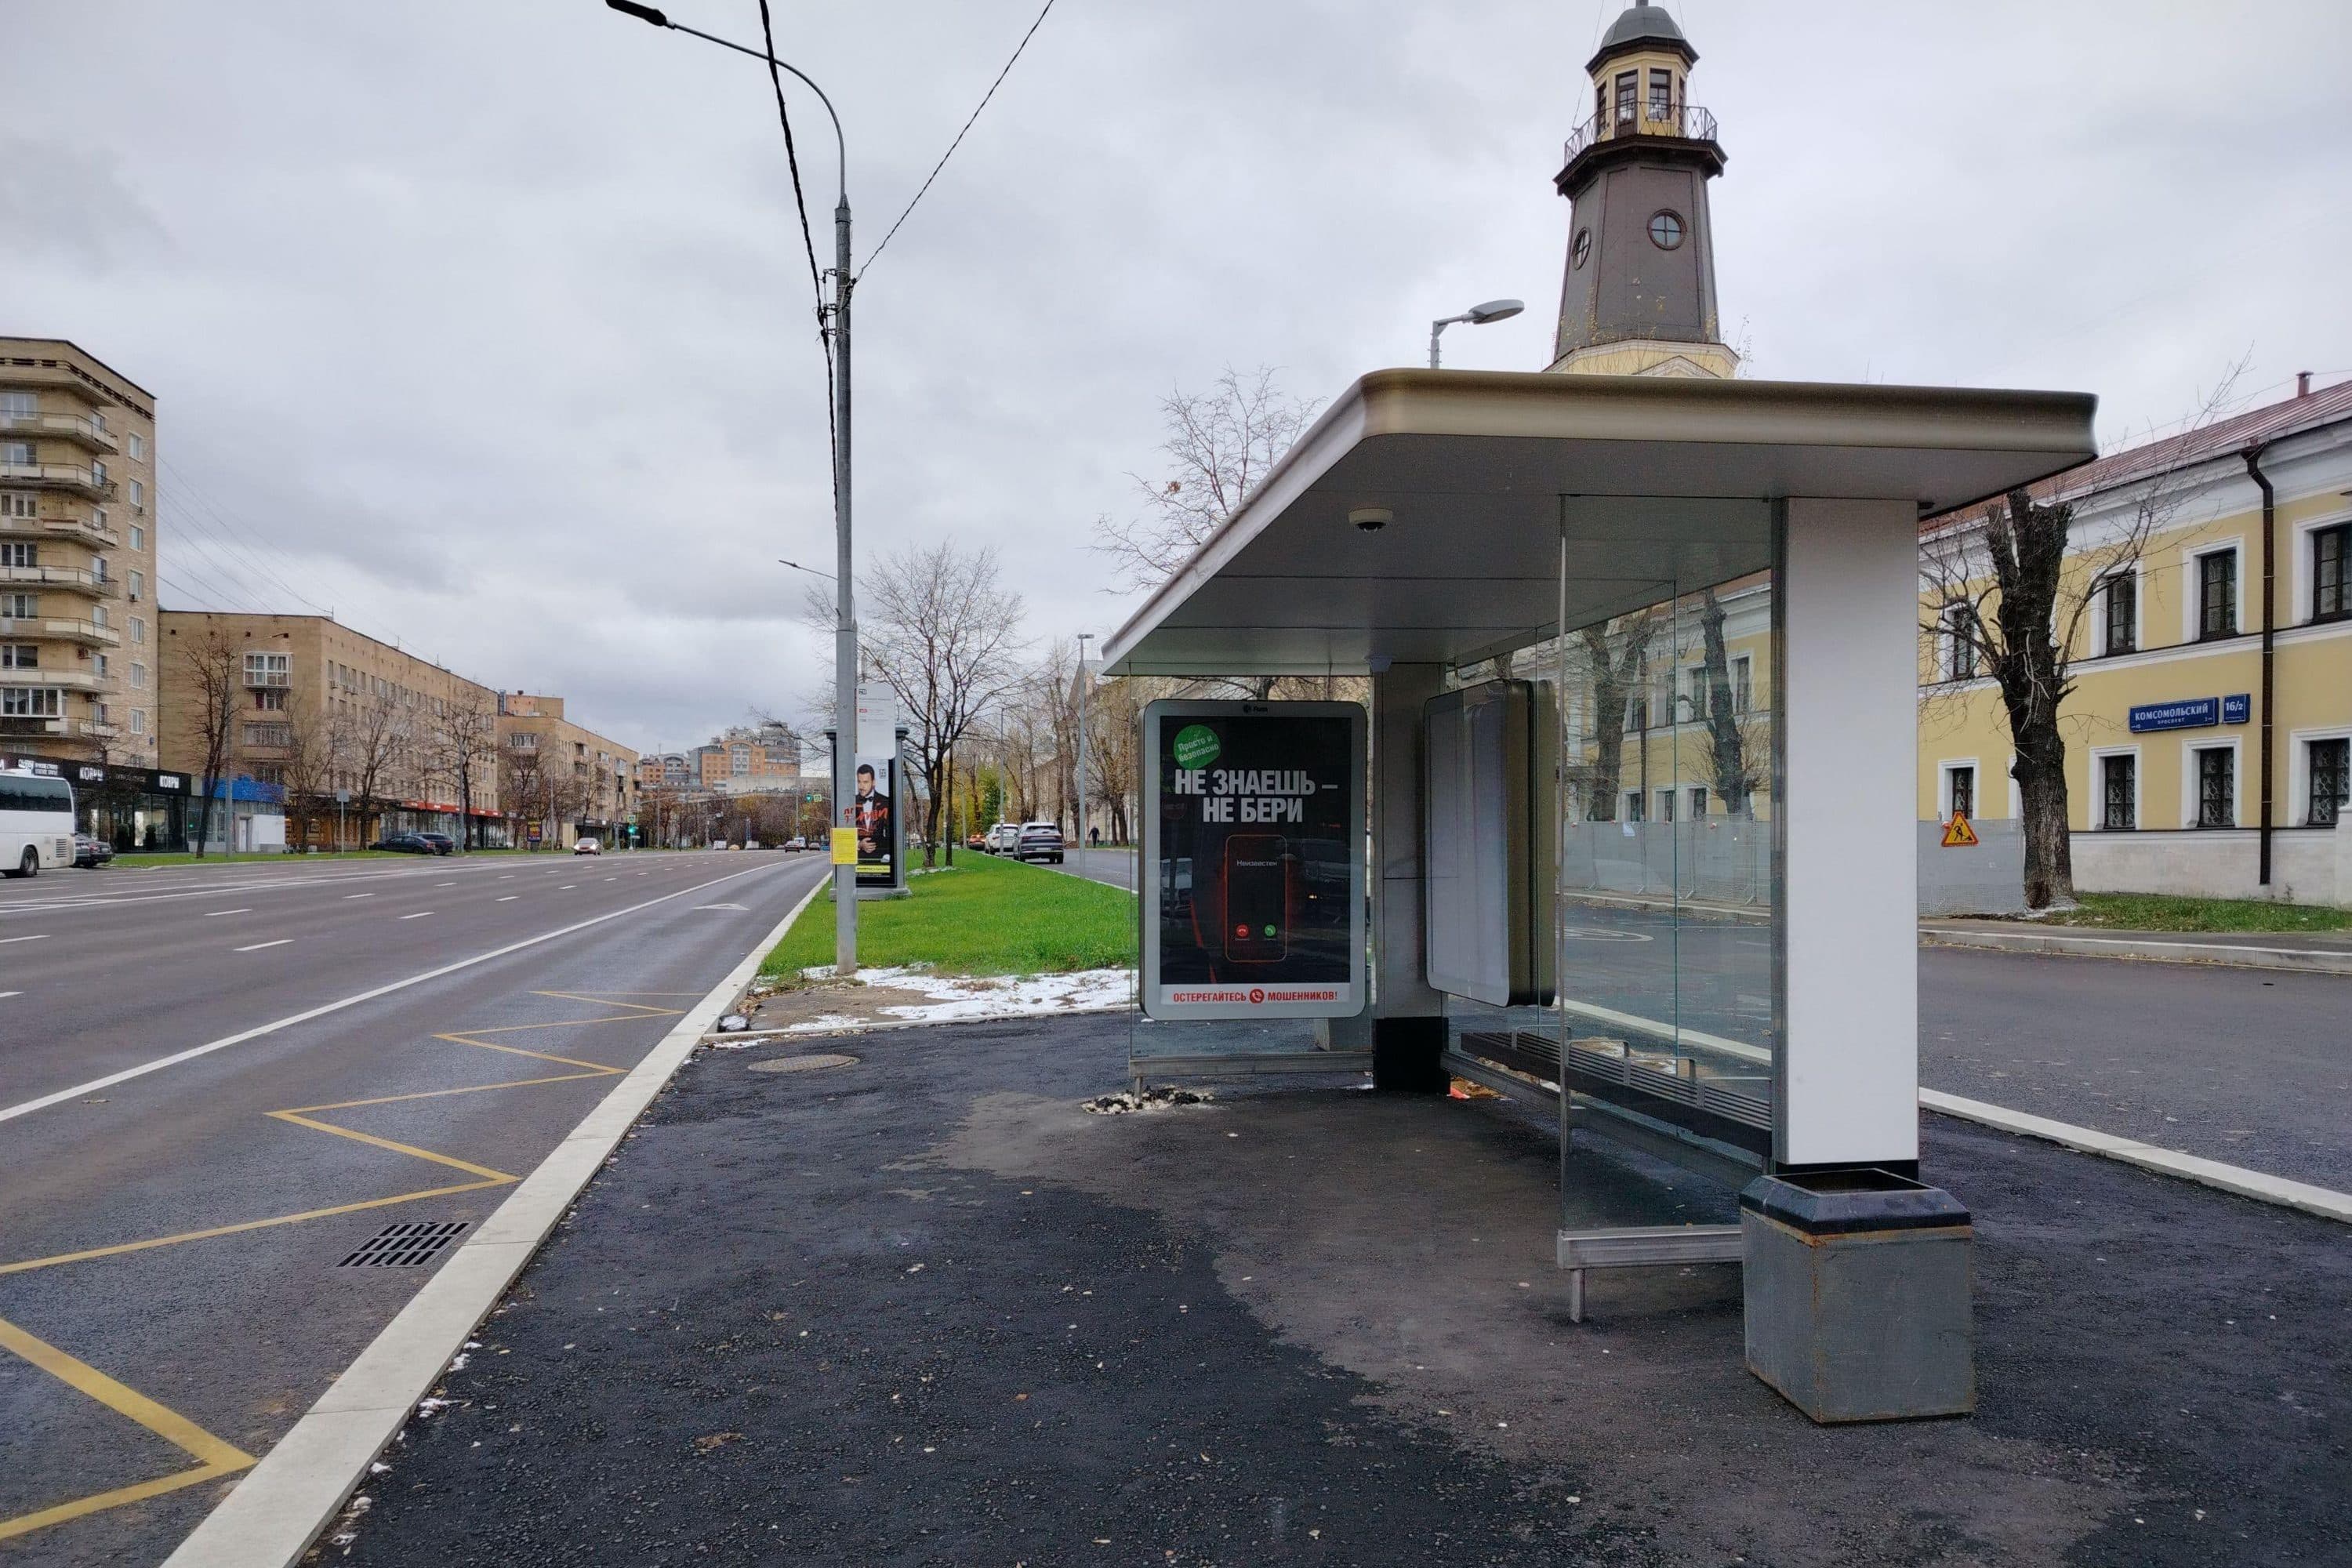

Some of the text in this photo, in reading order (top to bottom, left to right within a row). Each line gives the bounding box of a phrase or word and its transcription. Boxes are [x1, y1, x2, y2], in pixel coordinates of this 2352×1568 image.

[2135, 703, 2208, 721] КОМСОМОЛЬСКИЙ
[2226, 700, 2243, 712] 16/2
[1178, 738, 1206, 752] Просто
[1178, 743, 1219, 762] безопасно
[1175, 769, 1207, 795] НЕ
[1212, 769, 1316, 796] ЗНАЕШЬ
[1203, 797, 1303, 823] НЕ БЕРИ
[1173, 991, 1338, 1003] ОСТЕРЕГАЙТЕСЬ МОШЕННИКОВ!
